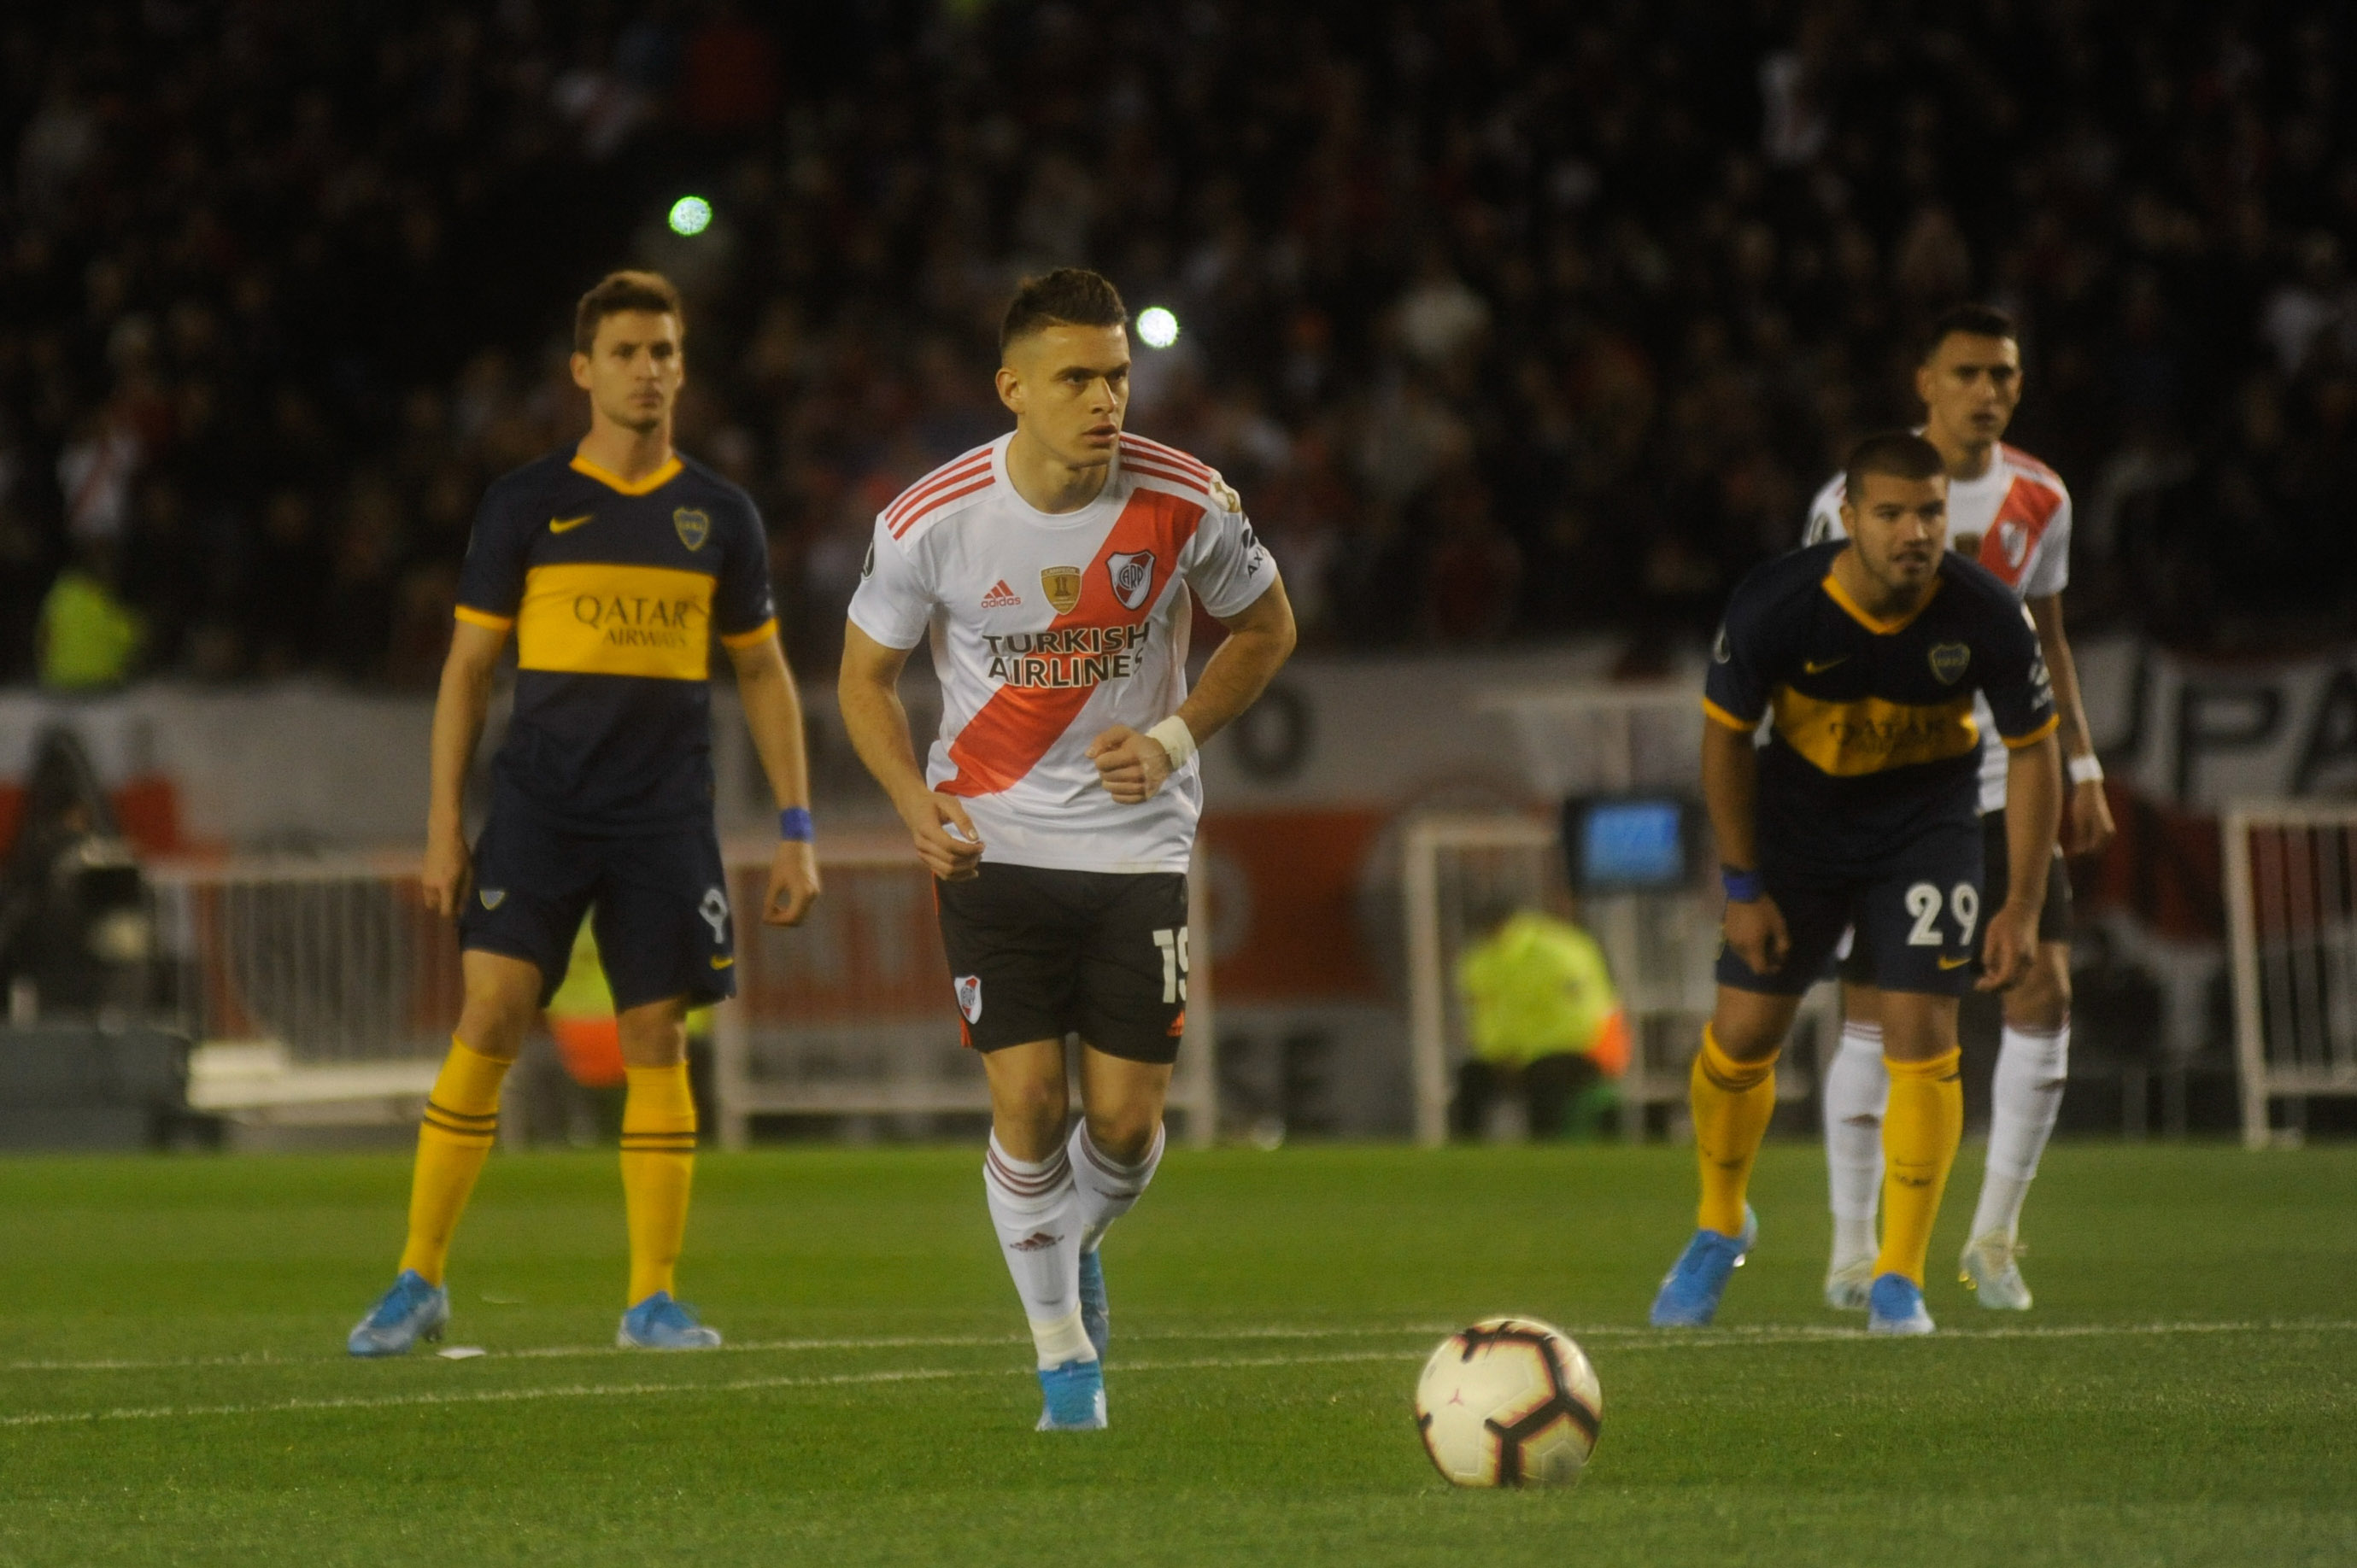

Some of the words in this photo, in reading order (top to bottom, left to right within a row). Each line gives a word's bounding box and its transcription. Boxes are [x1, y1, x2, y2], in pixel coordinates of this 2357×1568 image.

[573, 594, 687, 629] QATAR
[981, 596, 1021, 608] adidas
[982, 622, 1151, 655] TURKISH
[988, 647, 1143, 688] AIRLINES
[698, 887, 729, 944] 9
[1905, 883, 1979, 946] 29
